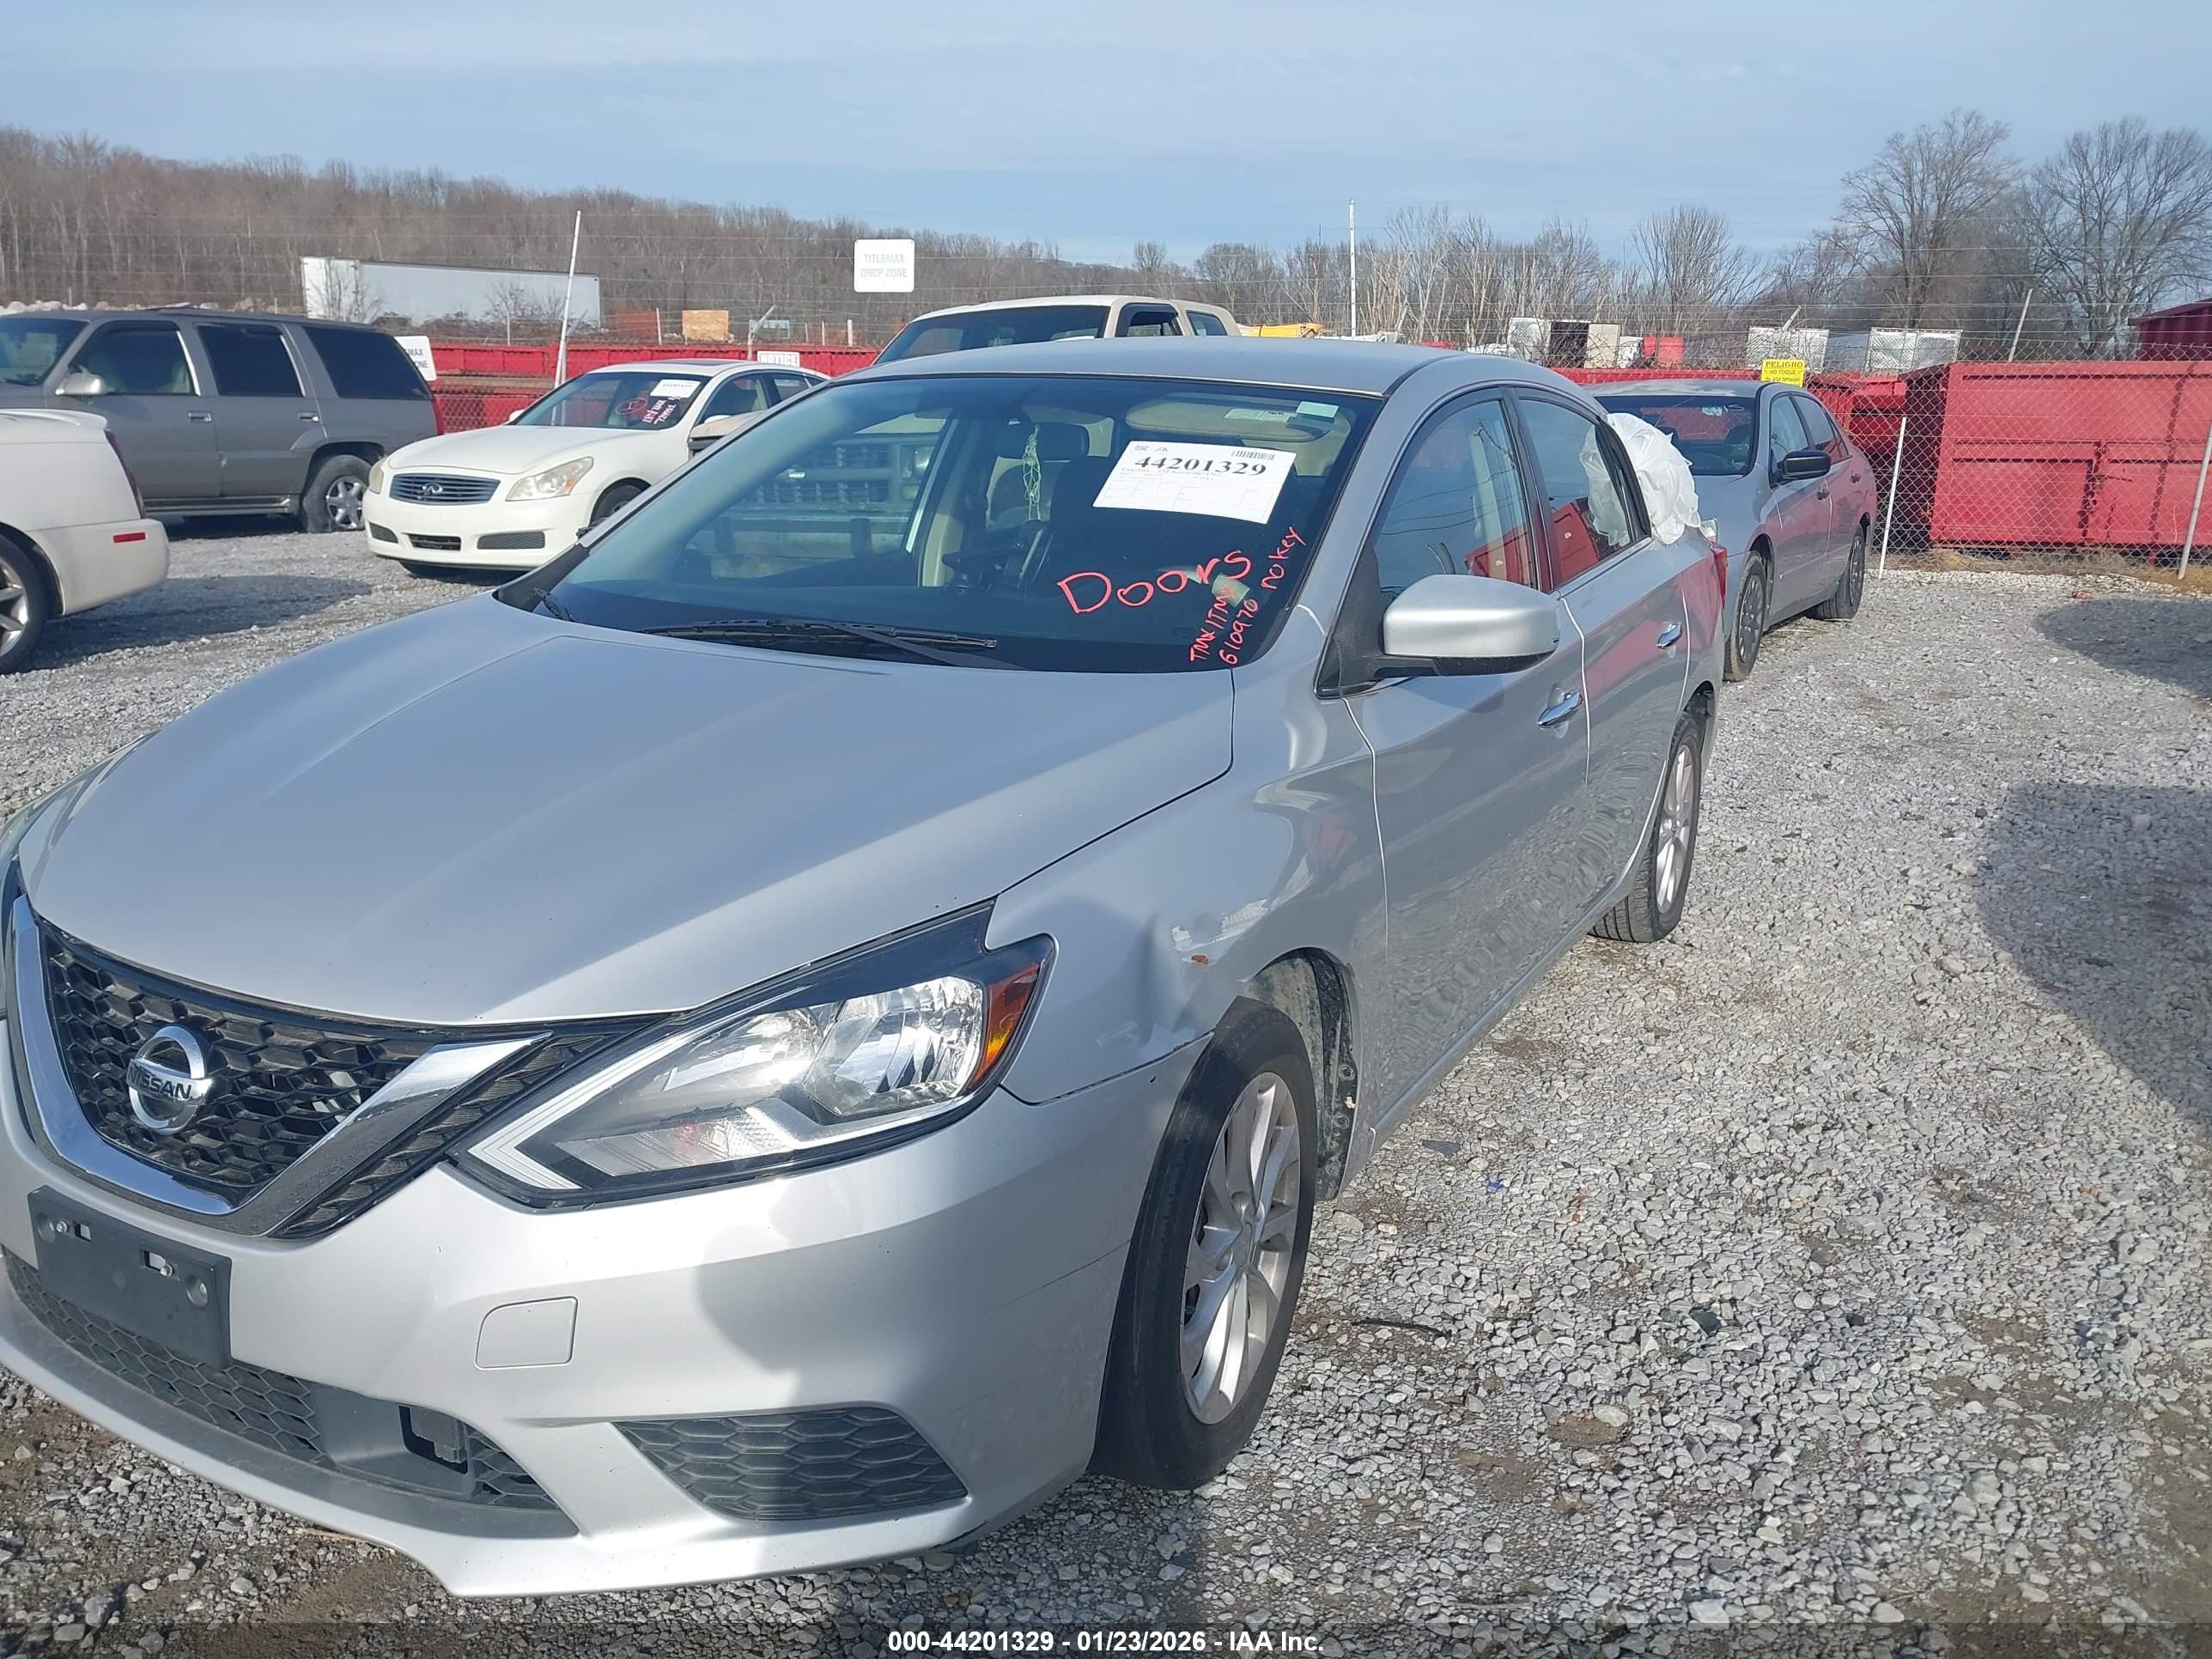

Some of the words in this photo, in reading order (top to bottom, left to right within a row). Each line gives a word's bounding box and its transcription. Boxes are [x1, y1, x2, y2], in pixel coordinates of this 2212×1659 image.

[864, 254, 905, 264] TITLEMAX
[860, 268, 884, 278] DROP
[885, 268, 908, 278] ZONE
[1133, 456, 1267, 476] 44201329
[1056, 549, 1251, 613] Doors
[1218, 599, 1259, 665] 610970
[130, 1065, 192, 1099] NISSAN
